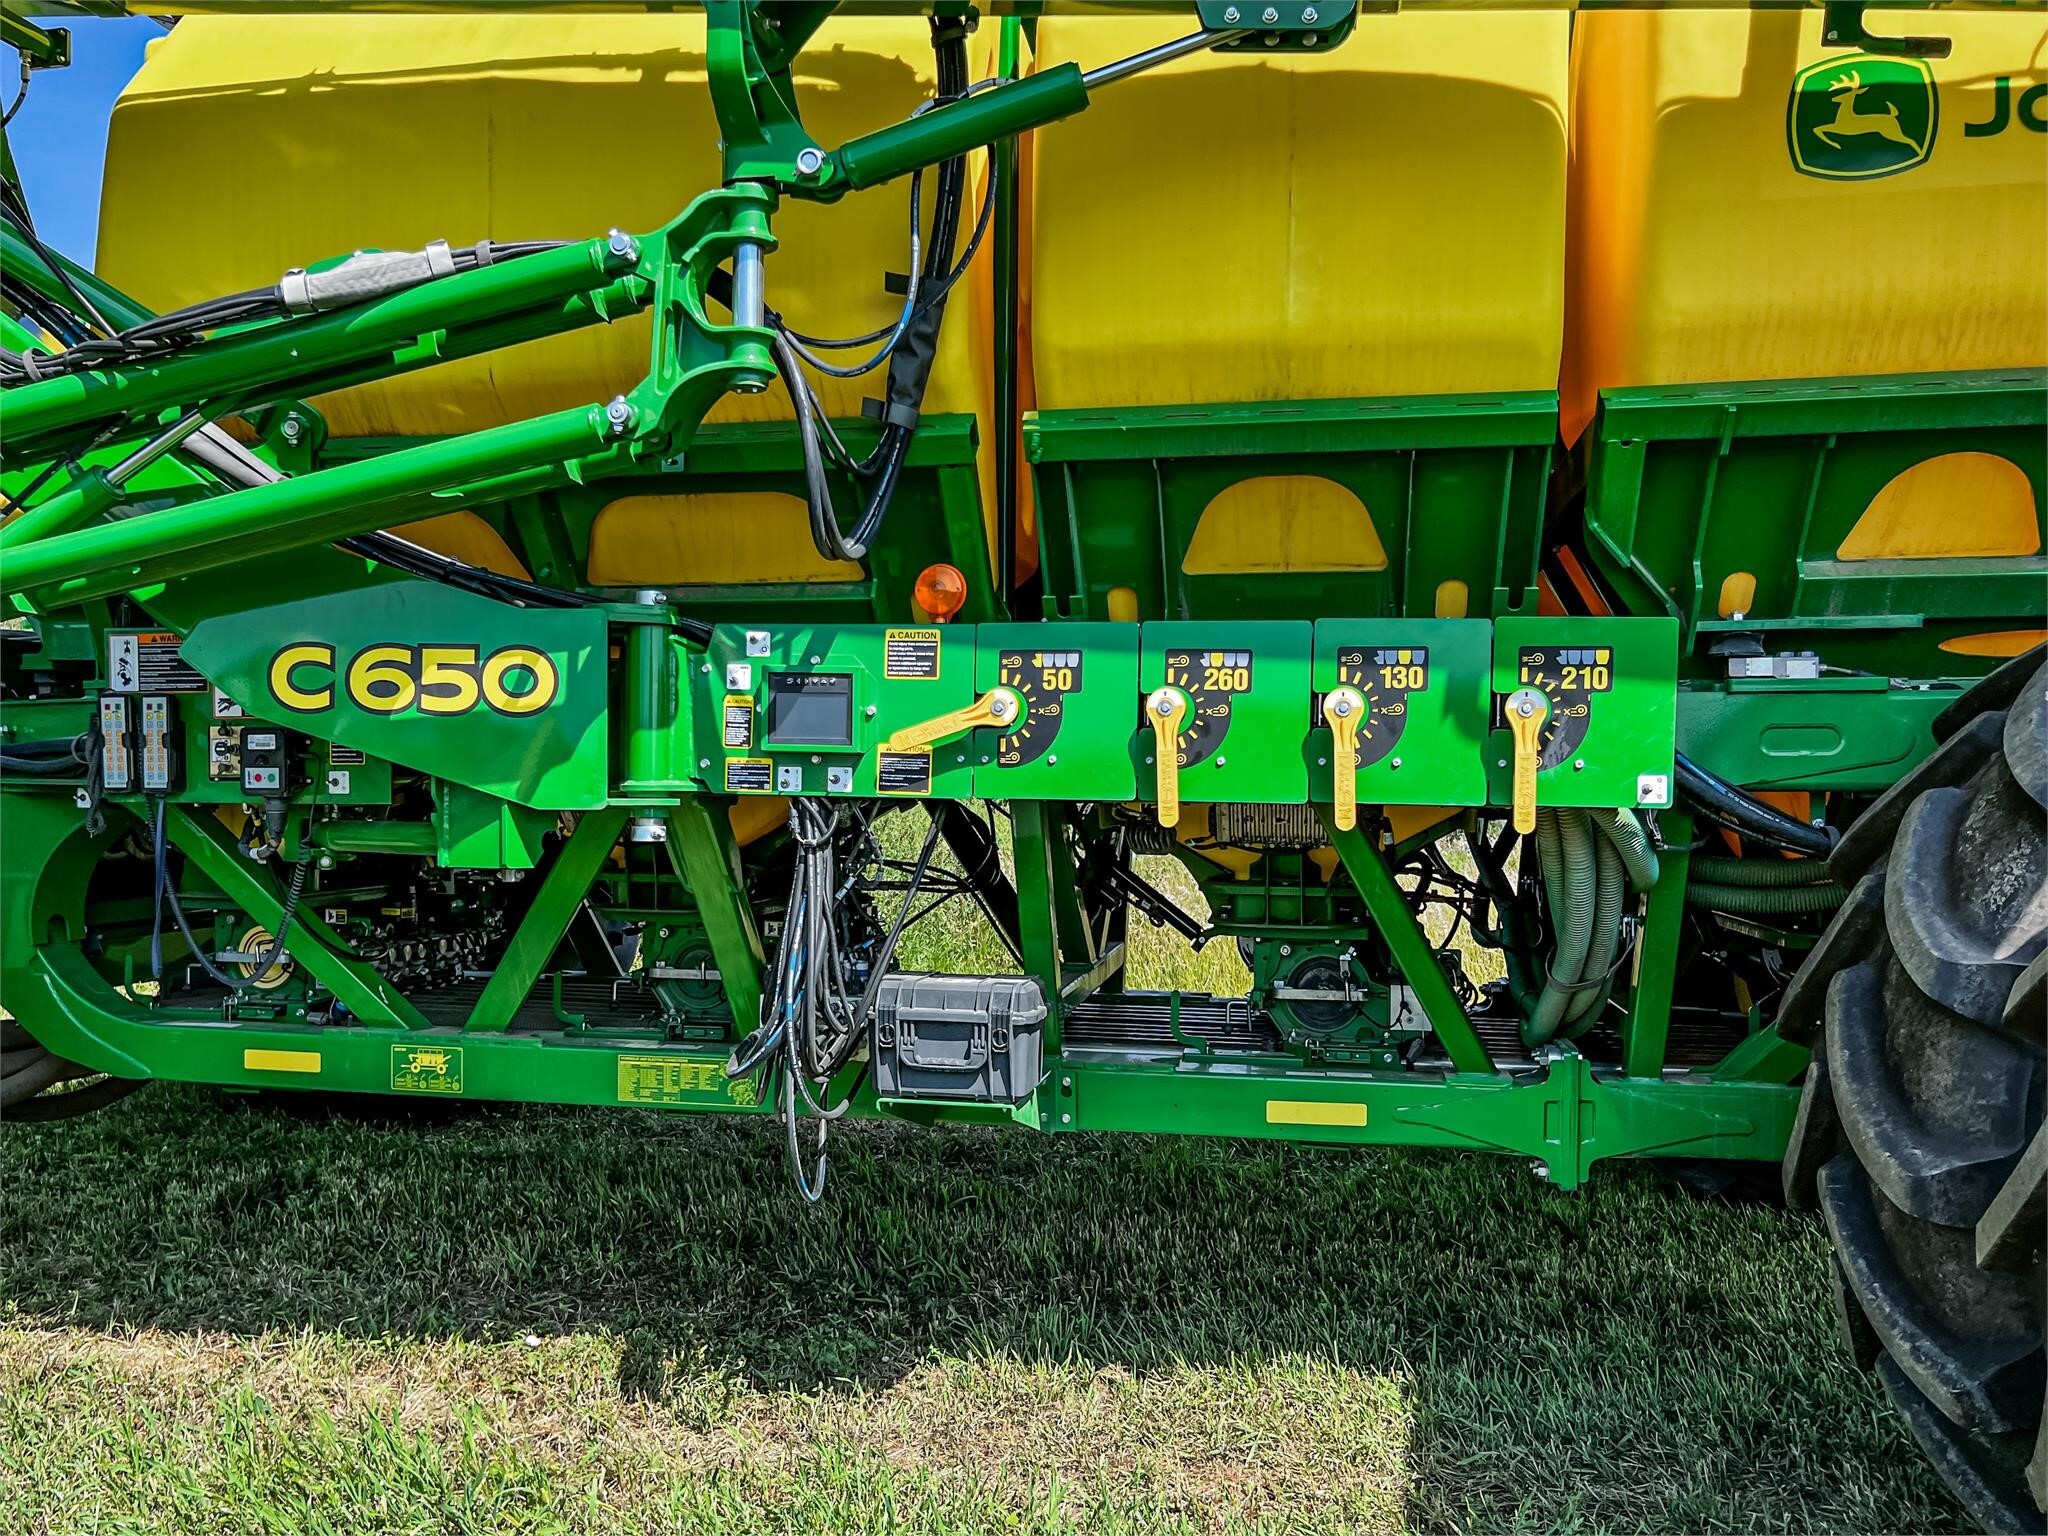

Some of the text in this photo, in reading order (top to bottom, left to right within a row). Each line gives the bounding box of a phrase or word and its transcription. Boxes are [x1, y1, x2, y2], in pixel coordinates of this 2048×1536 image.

[897, 631, 937, 640] CAUTION
[268, 642, 336, 714] C
[345, 642, 560, 718] 650
[1042, 668, 1073, 691] 50
[1203, 668, 1250, 691] 260
[1379, 666, 1425, 689] 130
[1560, 666, 1609, 690] 210
